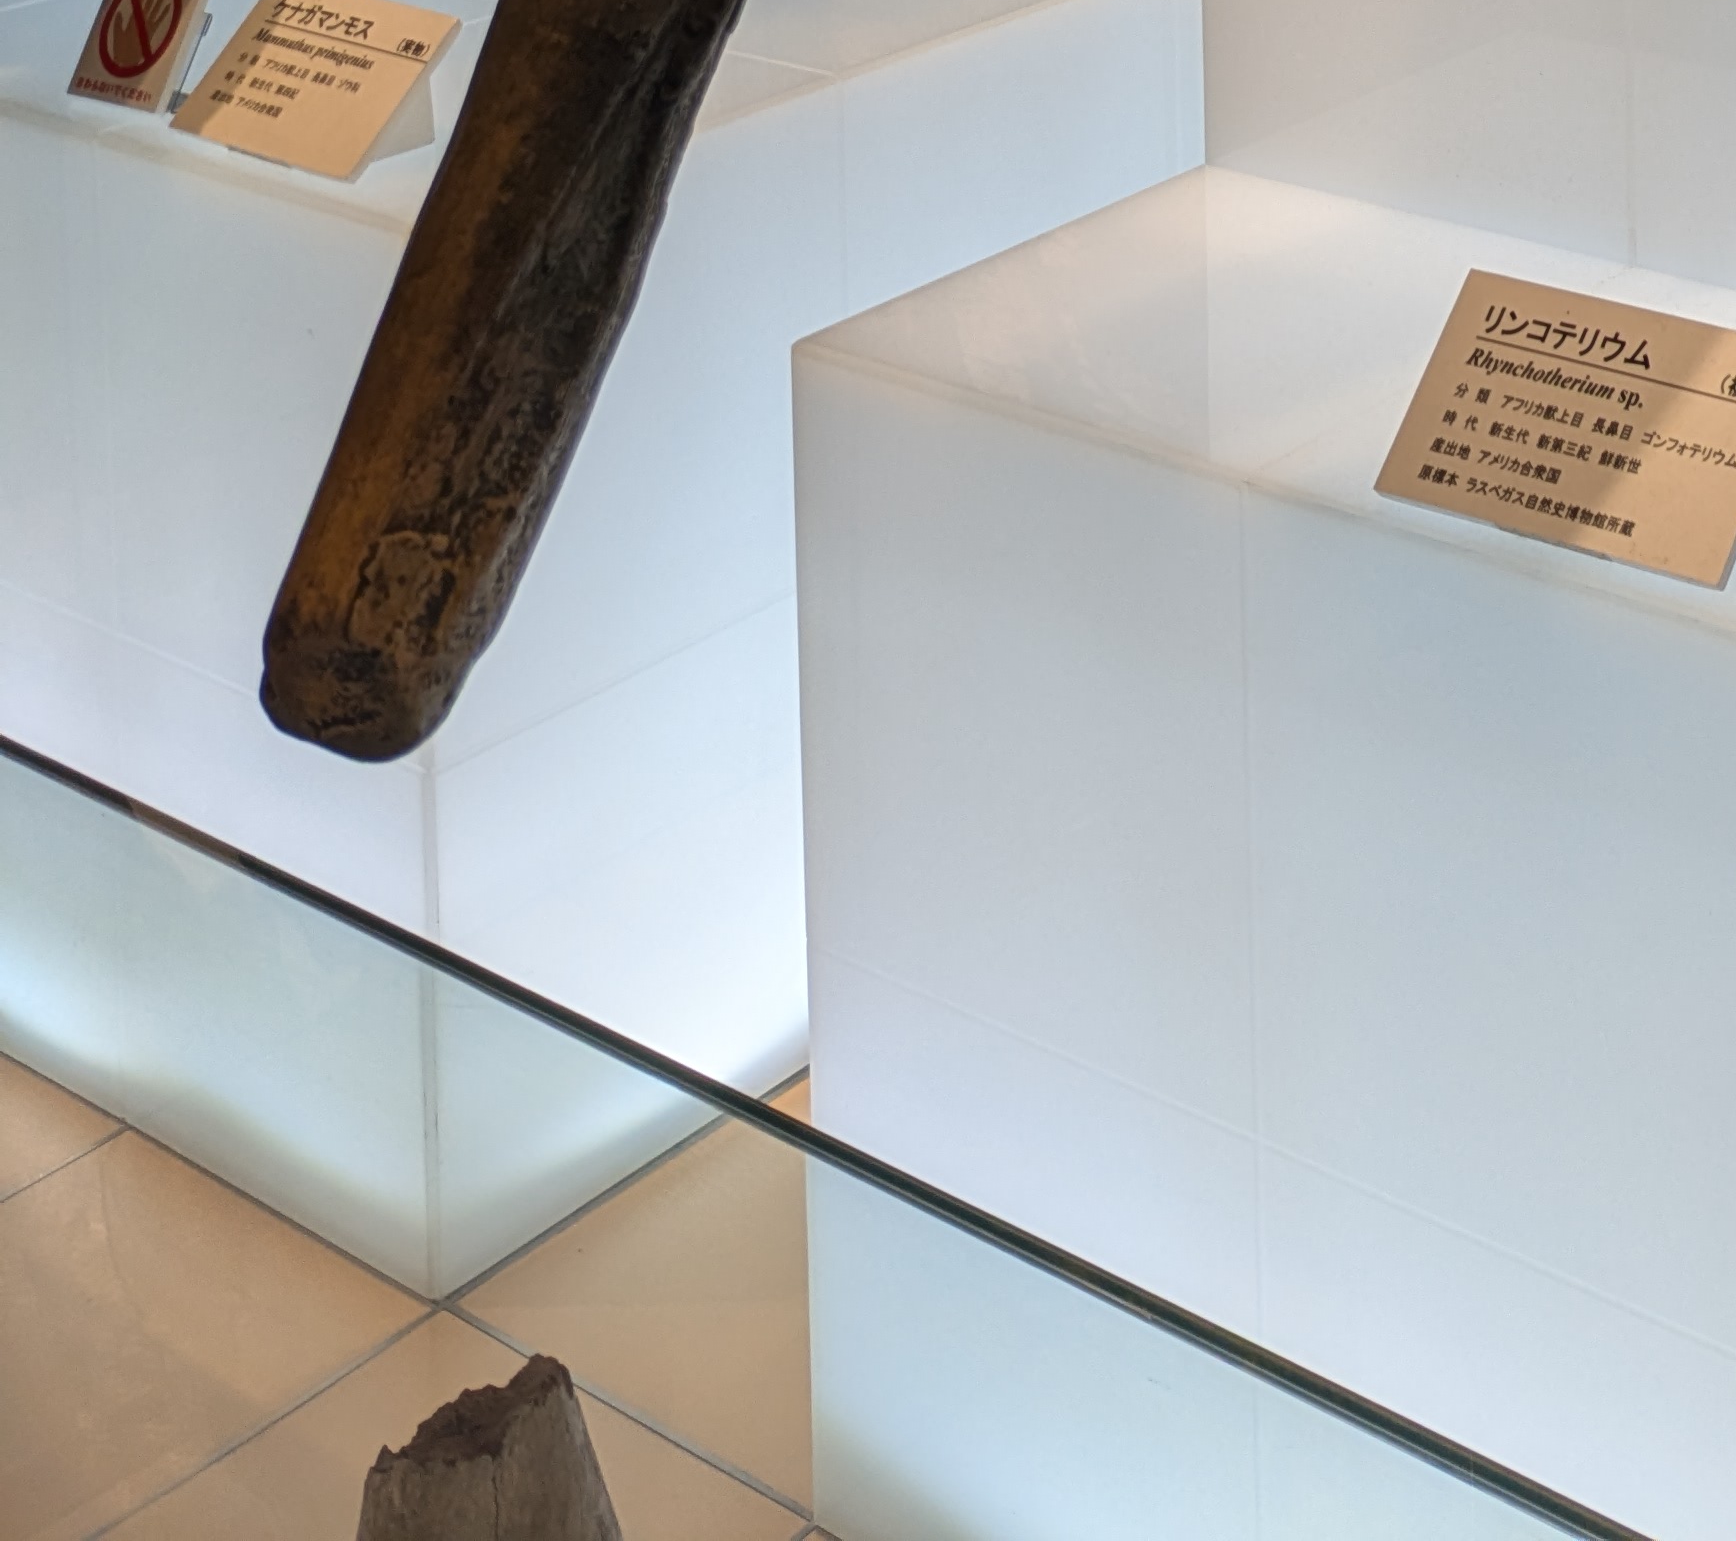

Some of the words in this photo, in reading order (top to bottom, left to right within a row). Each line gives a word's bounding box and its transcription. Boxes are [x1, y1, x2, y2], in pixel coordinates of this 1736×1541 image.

[310, 46, 376, 70] primigenius
[1485, 305, 1651, 370] リンコテリウム
[1465, 347, 1616, 400] Rhynchotherium
[1618, 390, 1644, 410] sp.
[1500, 395, 1584, 428] アフリカ獣上目
[1591, 417, 1634, 440] 長鼻目
[1429, 436, 1472, 460] 産出地
[1477, 449, 1562, 485] アメリカ合衆国
[1488, 421, 1530, 445] 新生代
[1536, 433, 1593, 462] 新第三紀
[1598, 449, 1642, 474] 鮮新世
[1417, 463, 1460, 487] 原標本
[1466, 477, 1636, 537] ラスベガス自然史博物館所蔵
